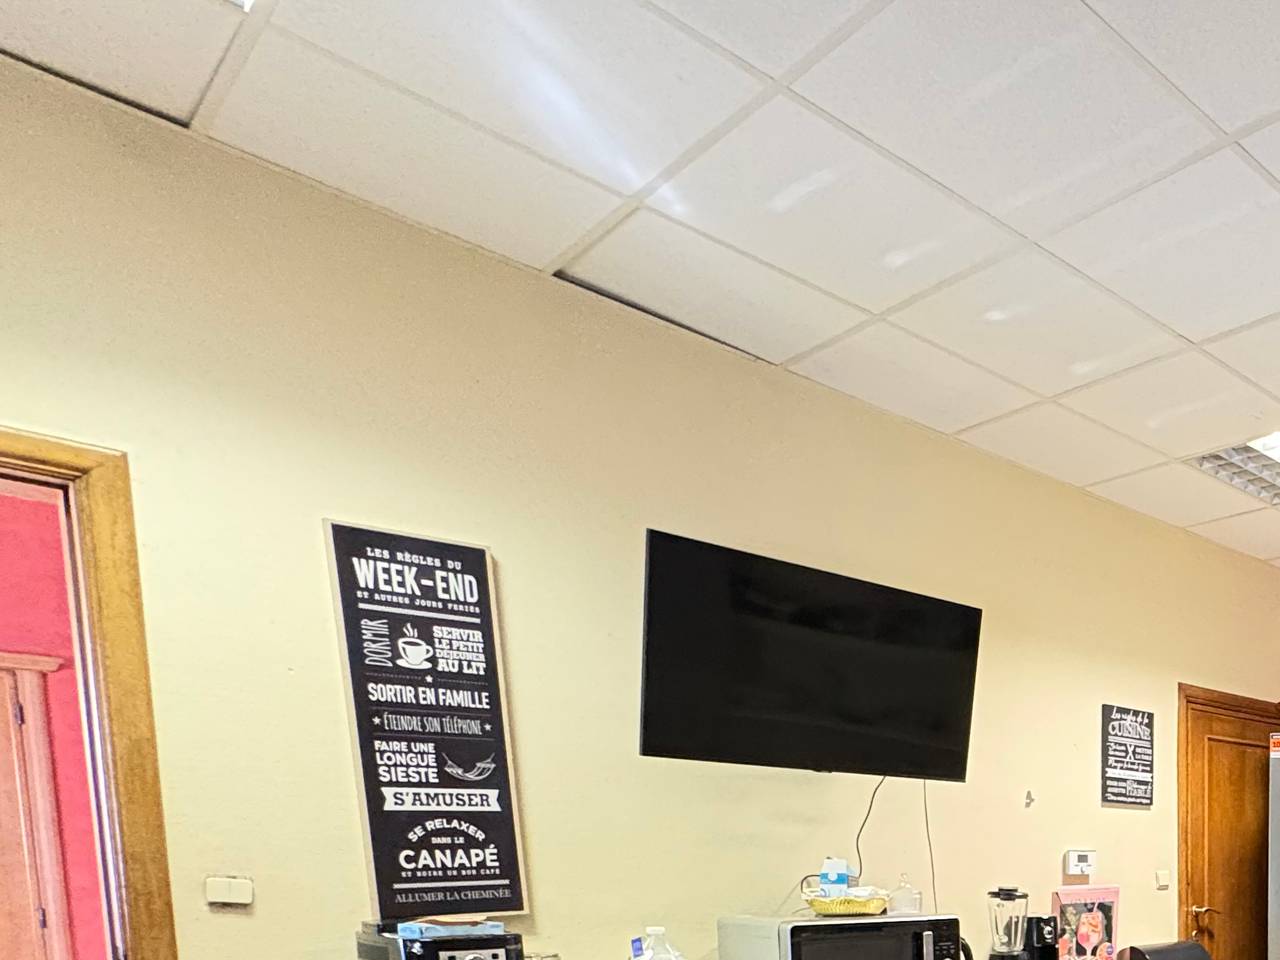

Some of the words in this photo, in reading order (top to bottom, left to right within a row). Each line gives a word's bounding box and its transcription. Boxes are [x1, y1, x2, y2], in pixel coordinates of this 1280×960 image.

[366, 547, 390, 559] LES
[447, 560, 463, 570] DU
[352, 557, 479, 603] WEEK-END
[361, 618, 393, 667] DORMIR
[432, 625, 484, 643] SERVIR
[433, 638, 450, 649] LE
[451, 640, 485, 653] PETIT
[436, 658, 459, 673] AU
[461, 660, 487, 675] LIT
[368, 683, 416, 704] SORTIR
[419, 687, 436, 706] EN
[438, 688, 490, 709] FAMILLE
[383, 712, 422, 732] ÉTEINDRE
[423, 717, 441, 733] SON
[373, 740, 408, 752] FAIRE
[411, 742, 436, 753] UNE
[375, 752, 438, 766] LONGUE
[378, 766, 440, 783] SIESTE
[393, 791, 492, 807] S'AMUSER
[408, 826, 426, 842] SE
[425, 818, 486, 842] RELAXER
[399, 843, 500, 870] CANAPÉ
[395, 892, 445, 903] ALLUMER
[446, 890, 460, 900] LA
